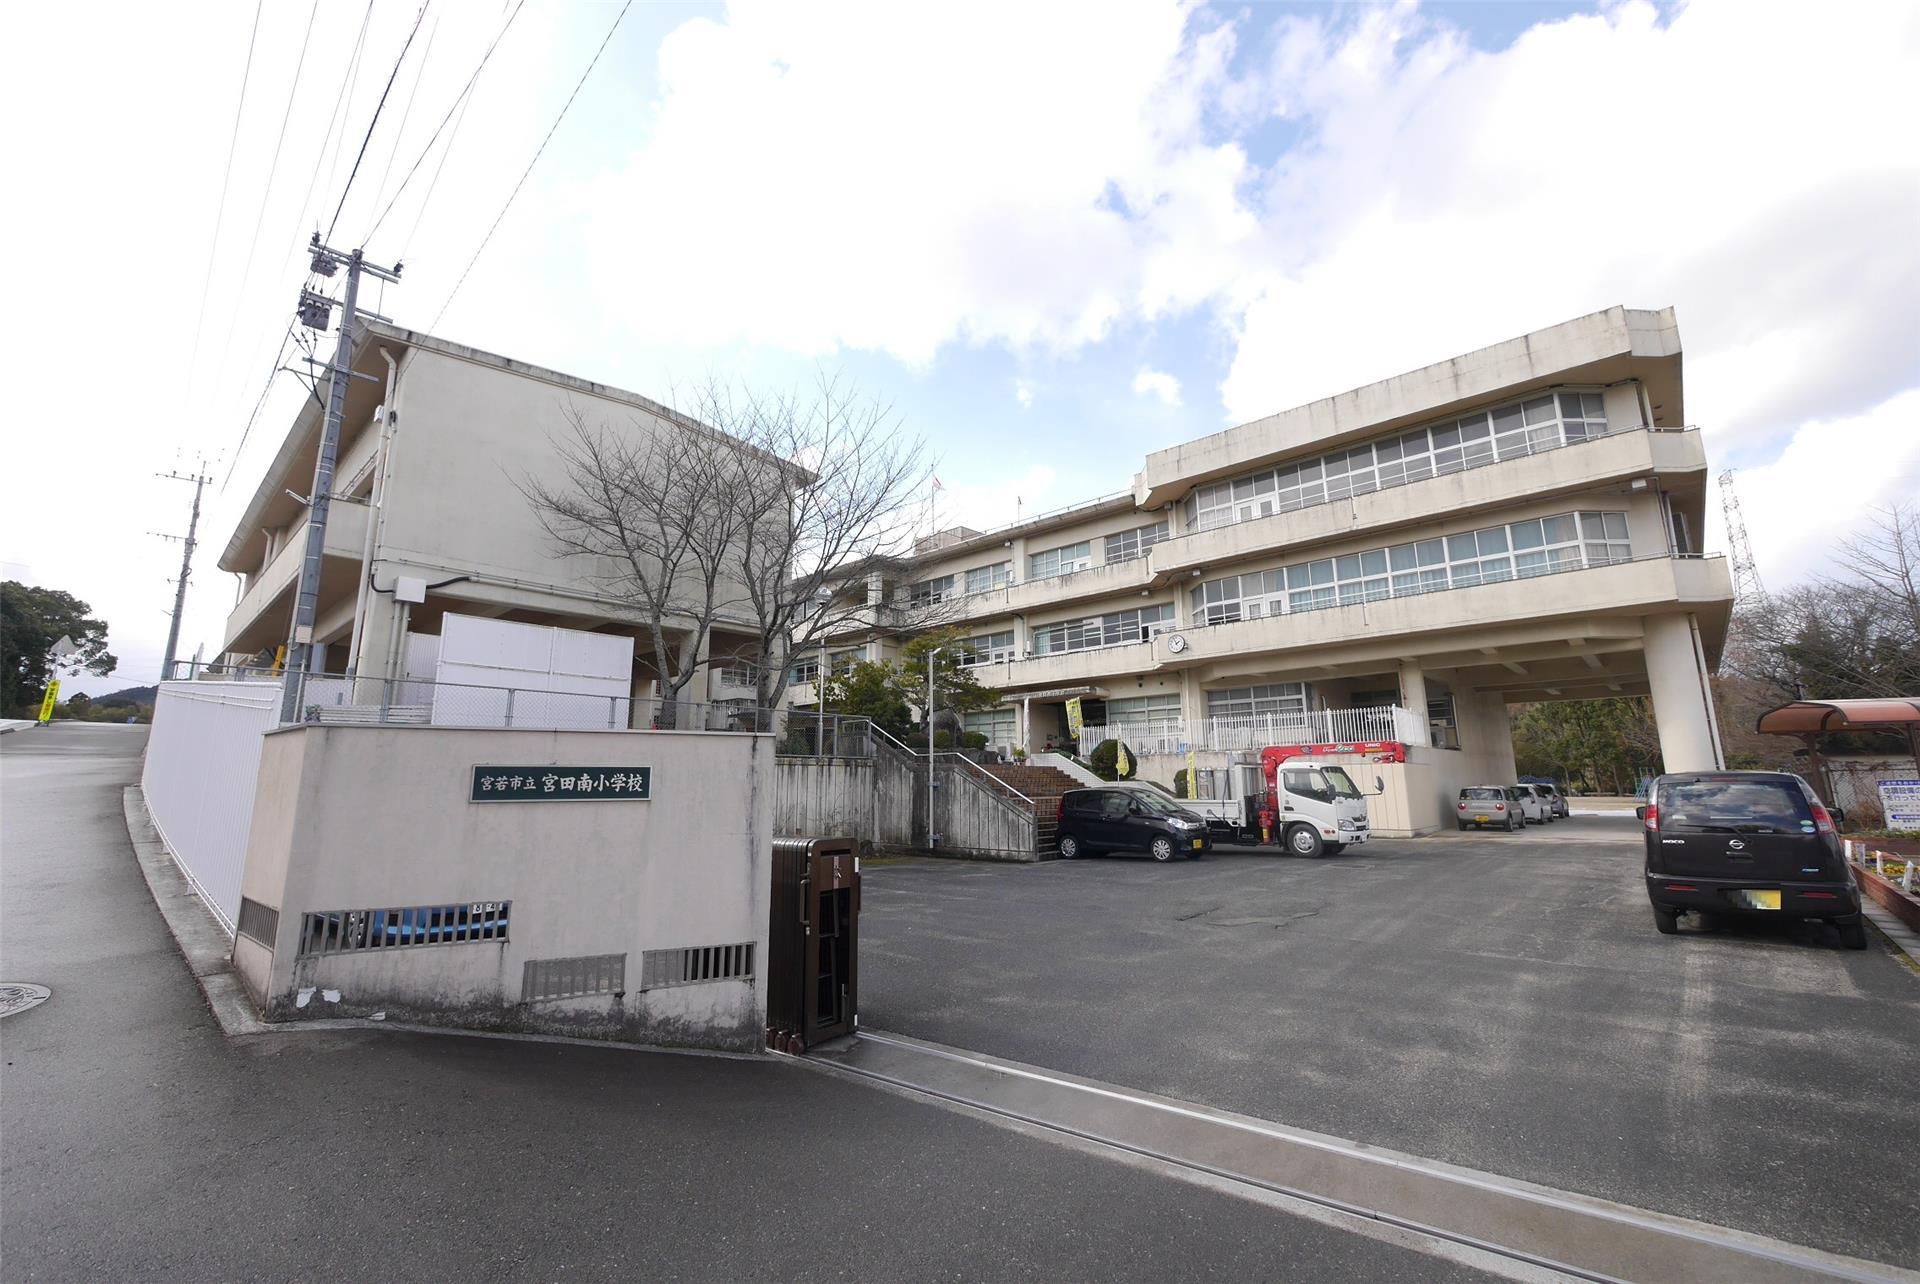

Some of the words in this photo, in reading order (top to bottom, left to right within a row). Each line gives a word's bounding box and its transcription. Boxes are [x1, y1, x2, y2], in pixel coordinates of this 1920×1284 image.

[480, 776, 537, 791] 宮若市立
[541, 773, 643, 792] 宮田南小学校
